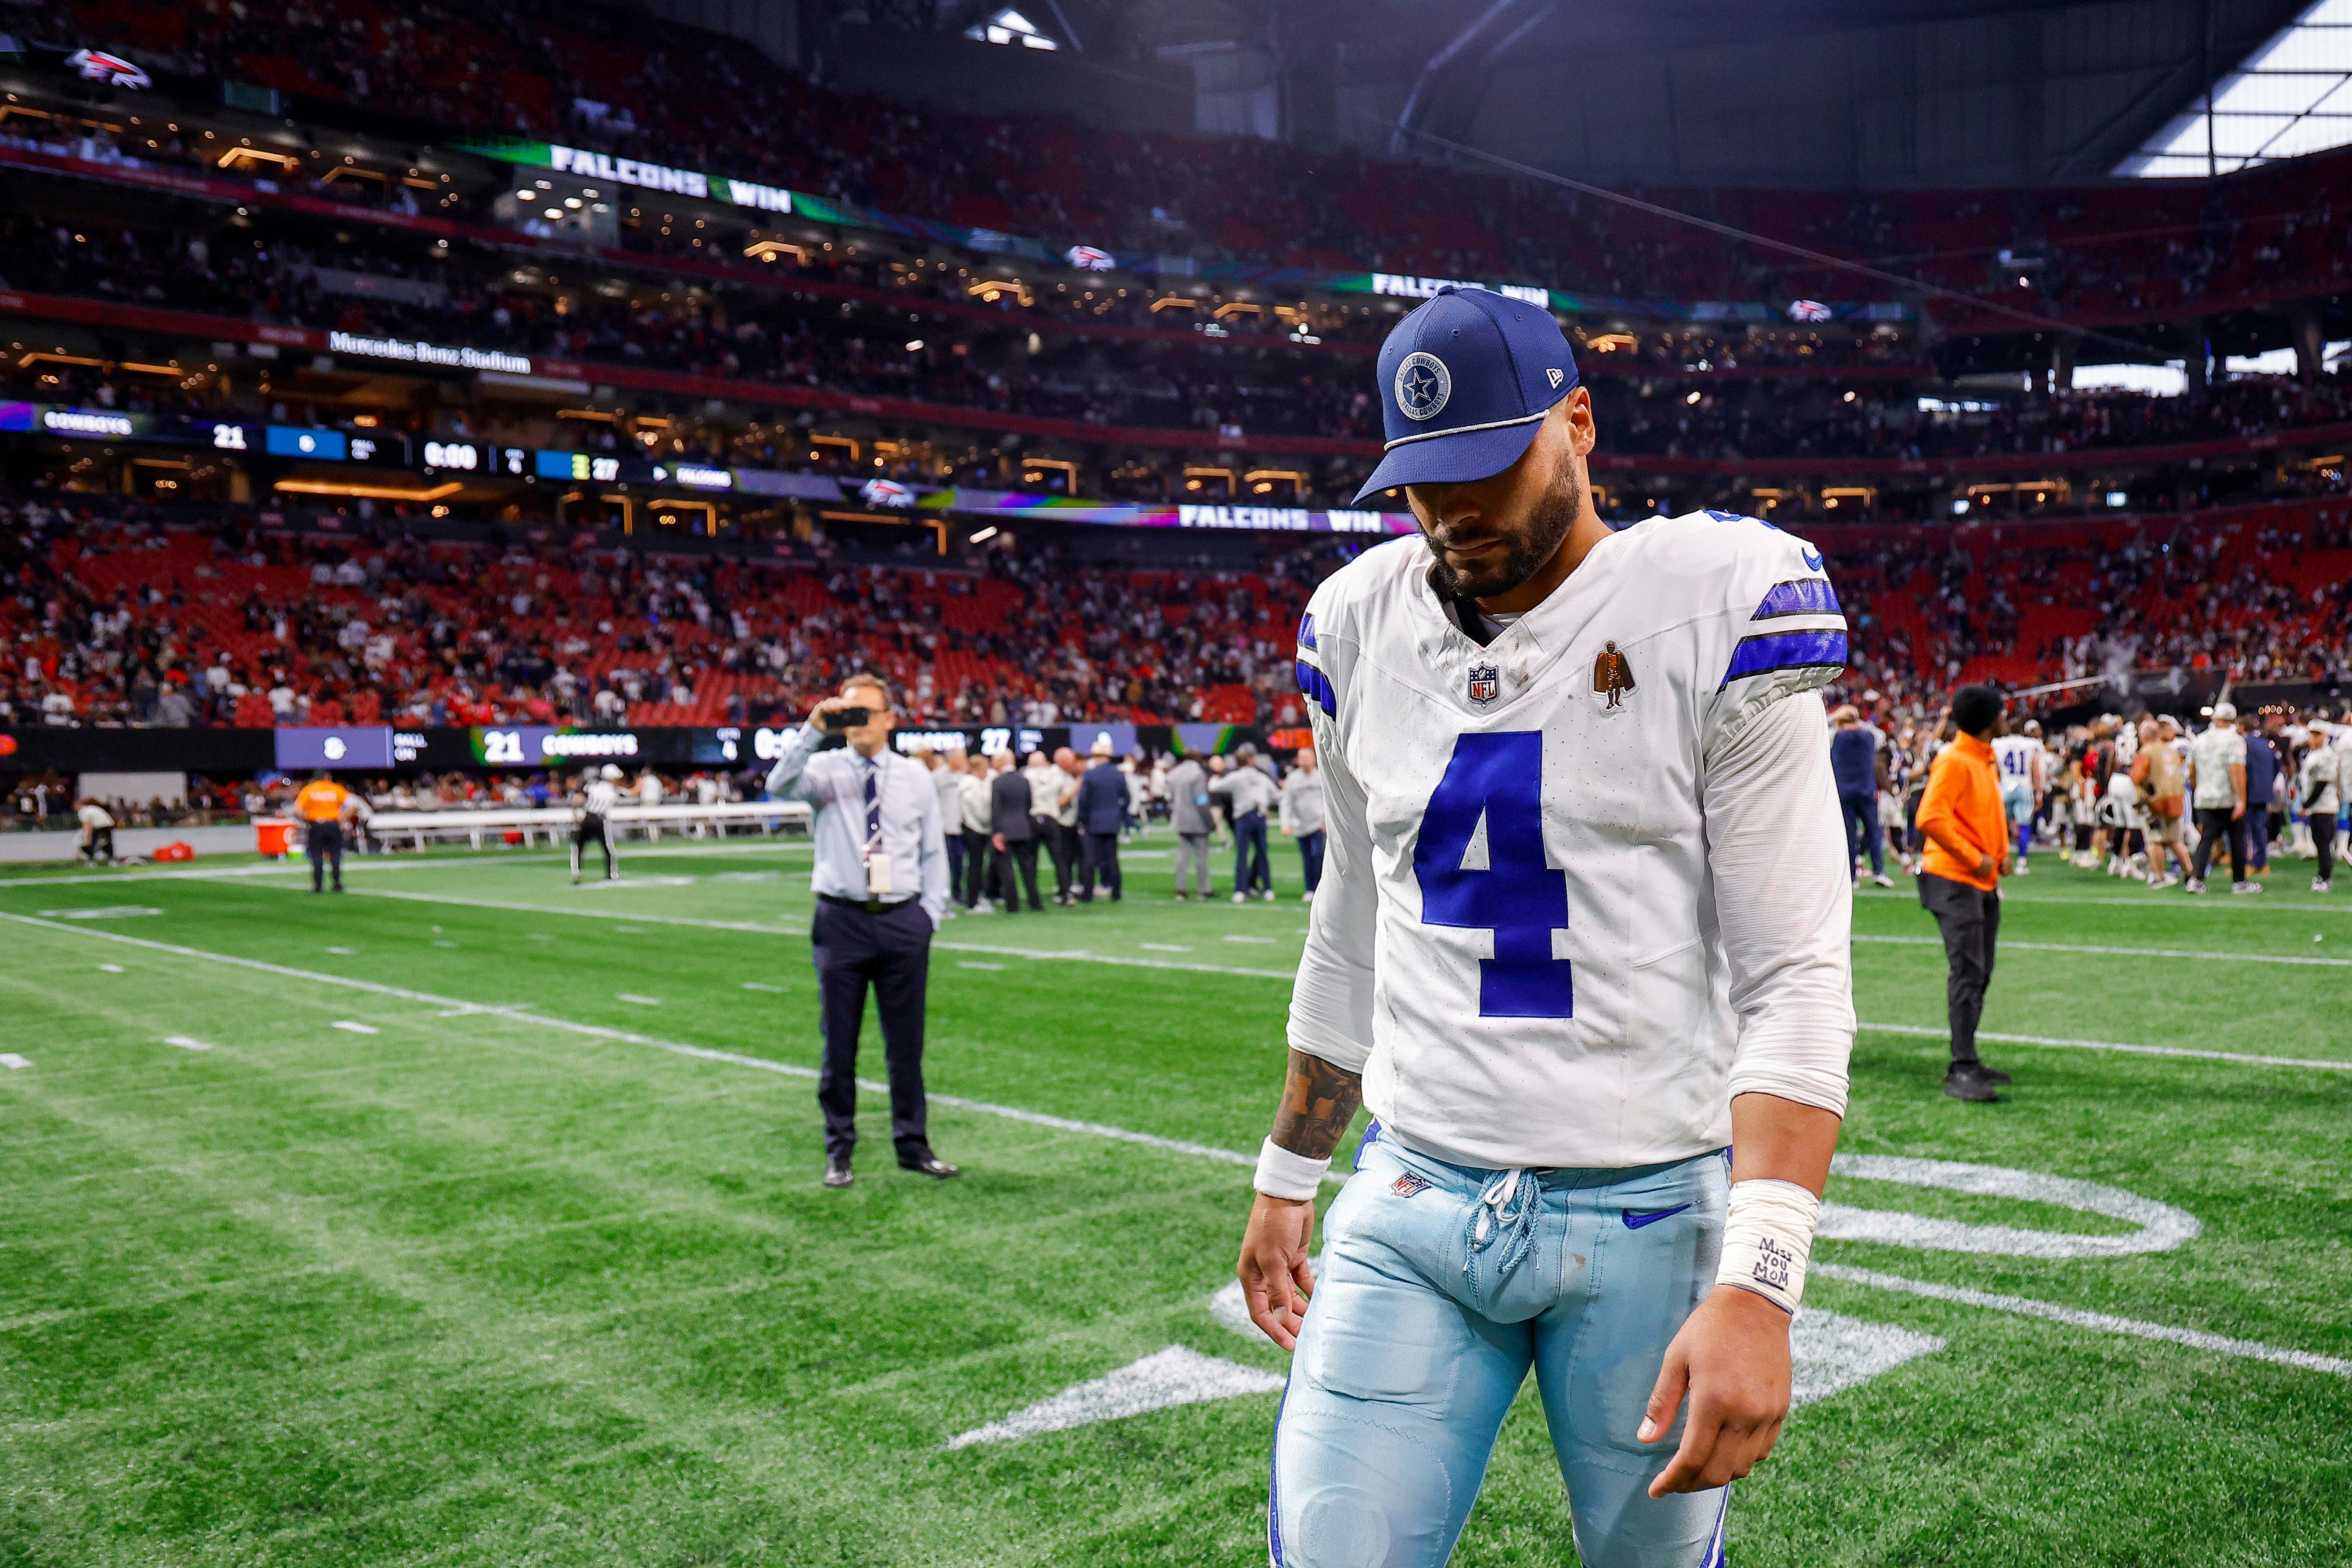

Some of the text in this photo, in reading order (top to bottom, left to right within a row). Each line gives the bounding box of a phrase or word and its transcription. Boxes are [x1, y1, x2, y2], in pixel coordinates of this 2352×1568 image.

[550, 144, 792, 214] FALCONS WIN
[1398, 357, 1441, 382] DALLAS COWBOYS
[1402, 392, 1445, 416] DALLAS COWBOYS
[44, 411, 132, 435] COWBOYS
[214, 424, 247, 450] 21
[1179, 504, 1382, 533] FALCONS WIN
[1472, 682, 1494, 699] NFL
[484, 730, 638, 762] 21 COWBOYS
[981, 727, 1011, 756] 27
[2004, 751, 2024, 775] 41
[1413, 730, 1573, 1018] 4
[1393, 1179, 1415, 1193] NFL
[1752, 1262, 1788, 1287] MOM
[1762, 1253, 1787, 1271] YOU
